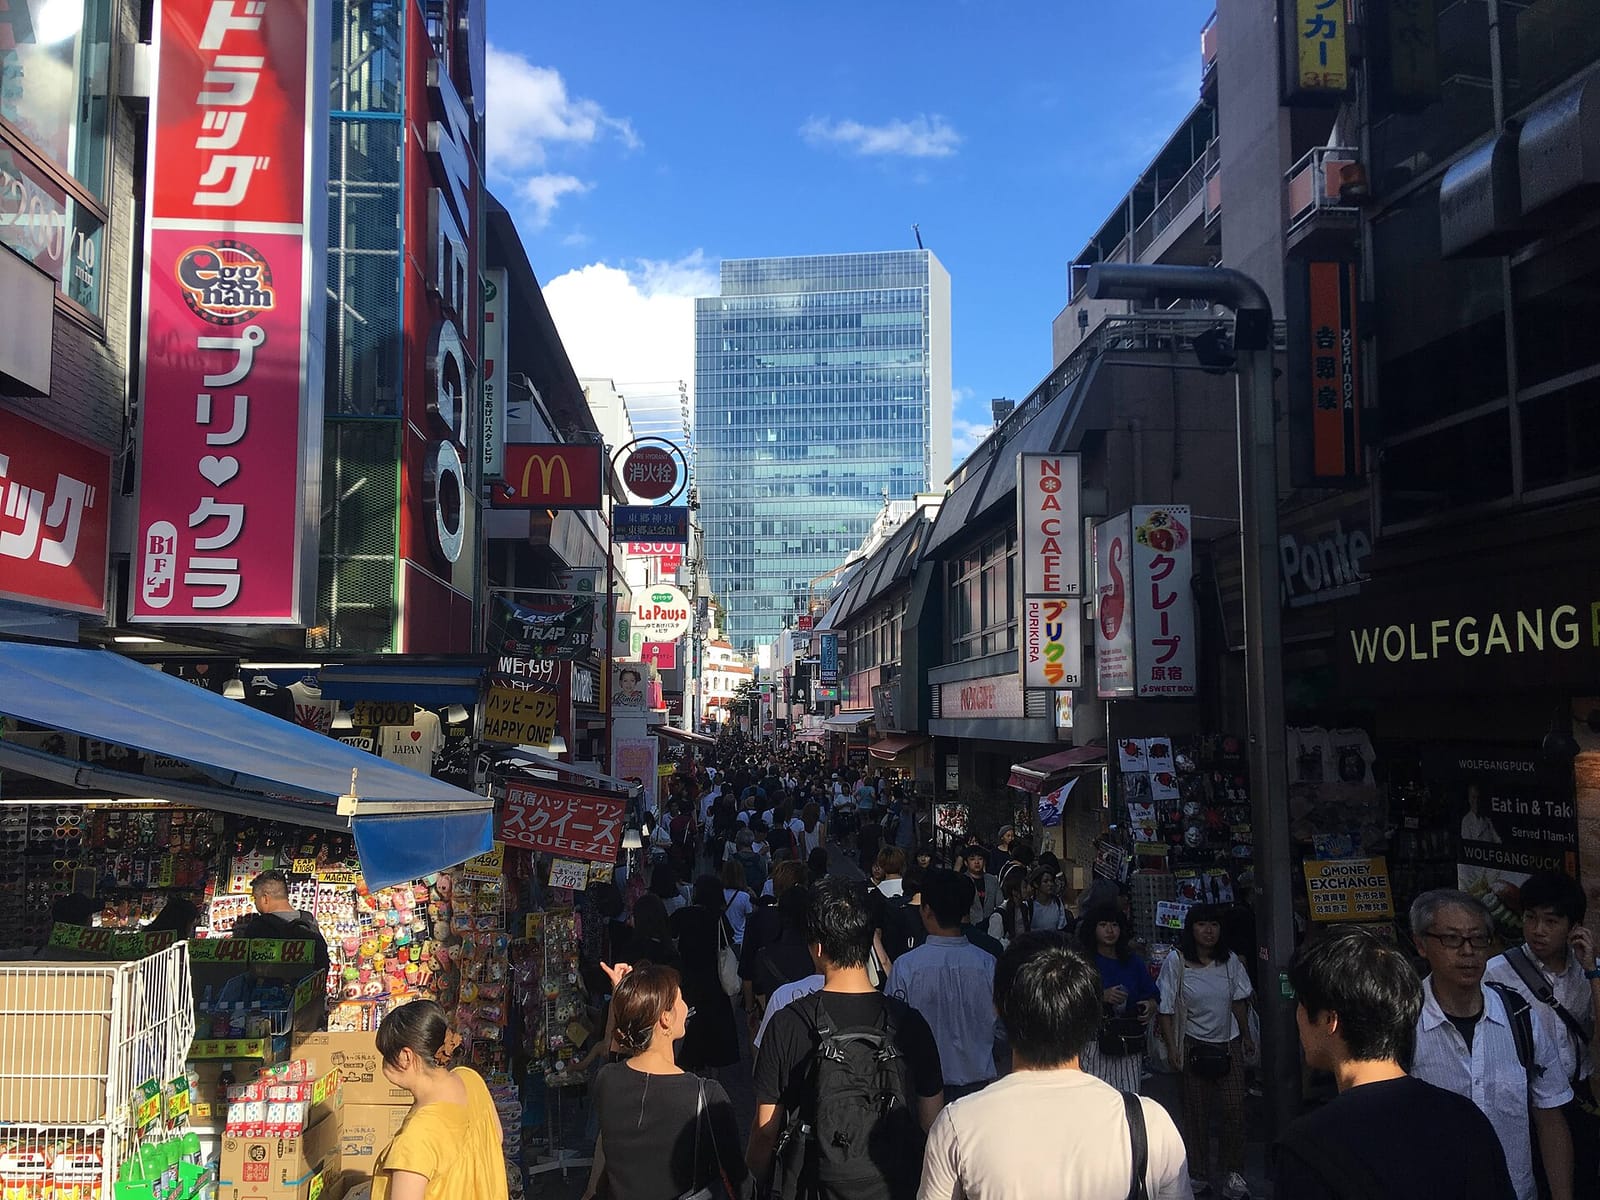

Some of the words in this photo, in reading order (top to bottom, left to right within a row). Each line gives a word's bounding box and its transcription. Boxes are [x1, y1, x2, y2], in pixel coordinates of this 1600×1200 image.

[1304, 72, 1344, 86] 3F
[193, 0, 270, 206] ドラッグ
[179, 249, 261, 291] egg
[203, 286, 273, 310] nam
[1342, 328, 1353, 408] YOSHINOYA
[629, 462, 672, 483] 消火栓
[1039, 459, 1061, 511] NOA
[0, 453, 95, 568] ッグ
[150, 535, 174, 554] B1
[153, 558, 167, 573] F
[1041, 519, 1061, 593] CAFE
[1280, 528, 1372, 598] Ponte
[1066, 584, 1077, 592] 1F
[639, 605, 652, 620] La
[653, 605, 687, 621] Pausa
[1149, 553, 1181, 664] クレープ
[522, 626, 566, 641] TRAP
[572, 633, 589, 645] 3F
[1028, 602, 1039, 663] PURIKURA
[1043, 601, 1067, 684] プリクラ
[1350, 604, 1580, 664] WOLFGANG
[1067, 674, 1078, 683] B1
[1151, 666, 1183, 681] 原宿
[1149, 684, 1177, 693] SWEET
[1178, 684, 1194, 693] BOX
[489, 693, 556, 719] ハッピーワン
[396, 731, 400, 740] I
[483, 717, 523, 740] HAPPY
[392, 744, 422, 755] JAPAN
[508, 789, 622, 818] 原宿ハッピーワン
[1491, 797, 1511, 813] Eat
[1515, 798, 1529, 814] in
[1532, 803, 1541, 815] &
[504, 804, 621, 844] スクイーズ
[1511, 826, 1541, 840] Served
[501, 828, 616, 857] SQUEEZE
[1331, 865, 1372, 876] MONEY
[1310, 876, 1387, 890] EXCHANGE
